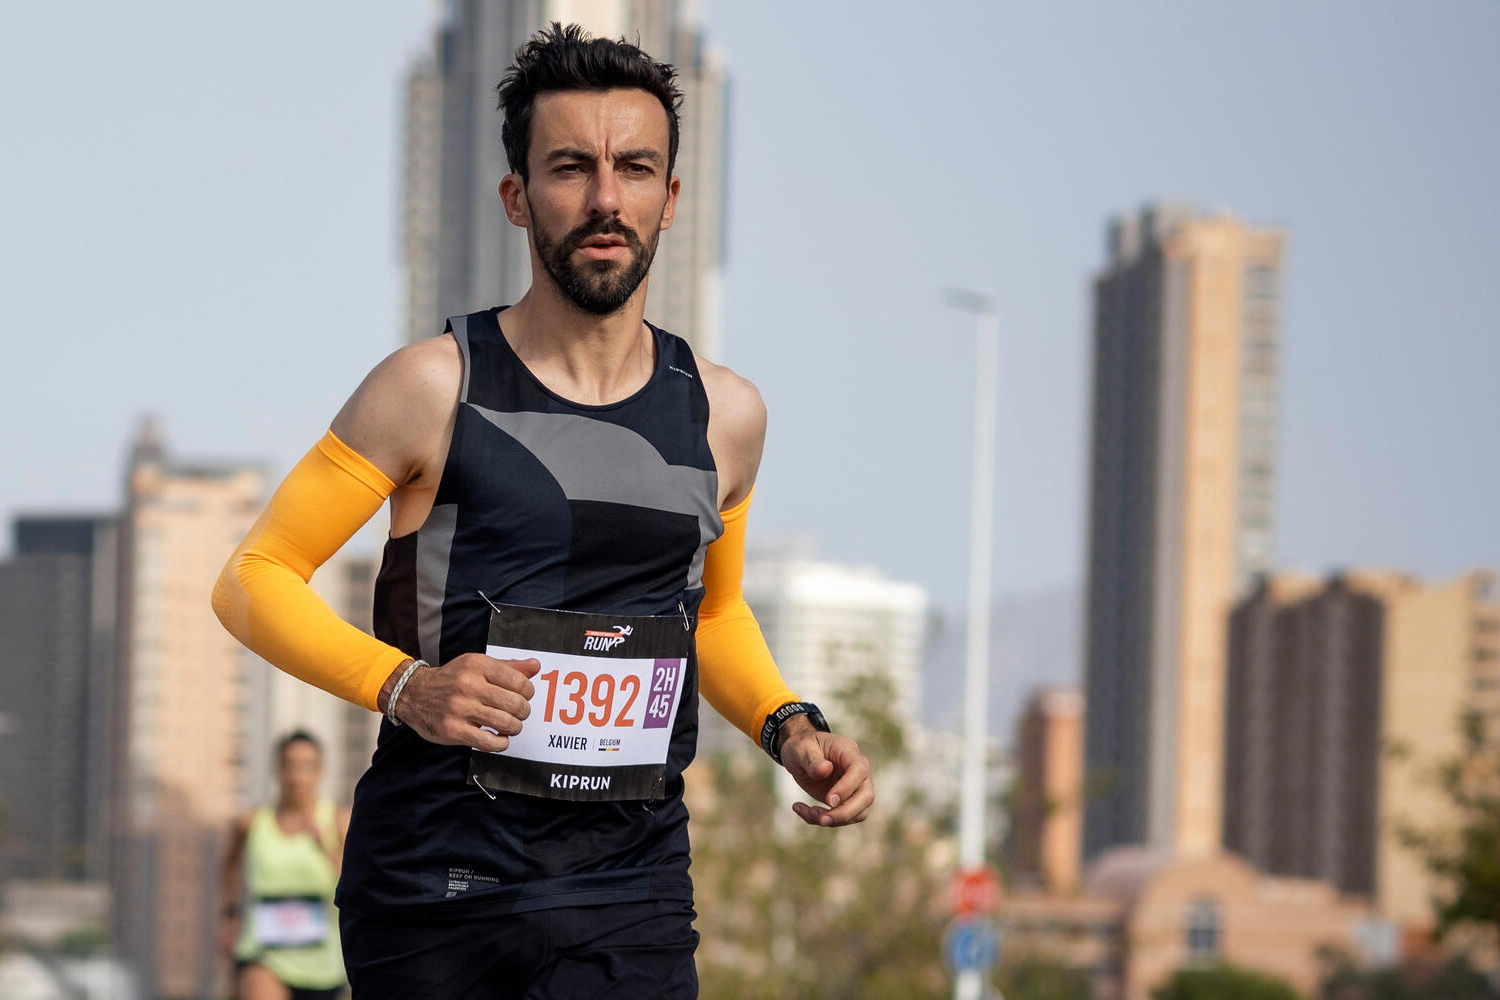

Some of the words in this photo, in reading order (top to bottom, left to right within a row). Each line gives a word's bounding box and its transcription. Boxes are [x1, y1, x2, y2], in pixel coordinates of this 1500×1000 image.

[583, 636, 612, 651] RUN
[653, 667, 676, 692] 2H
[540, 669, 640, 727] 1392
[649, 694, 670, 719] 45
[548, 734, 588, 750] XAVIER
[599, 738, 621, 746] BELGIUM
[550, 773, 611, 790] KIPRUN
